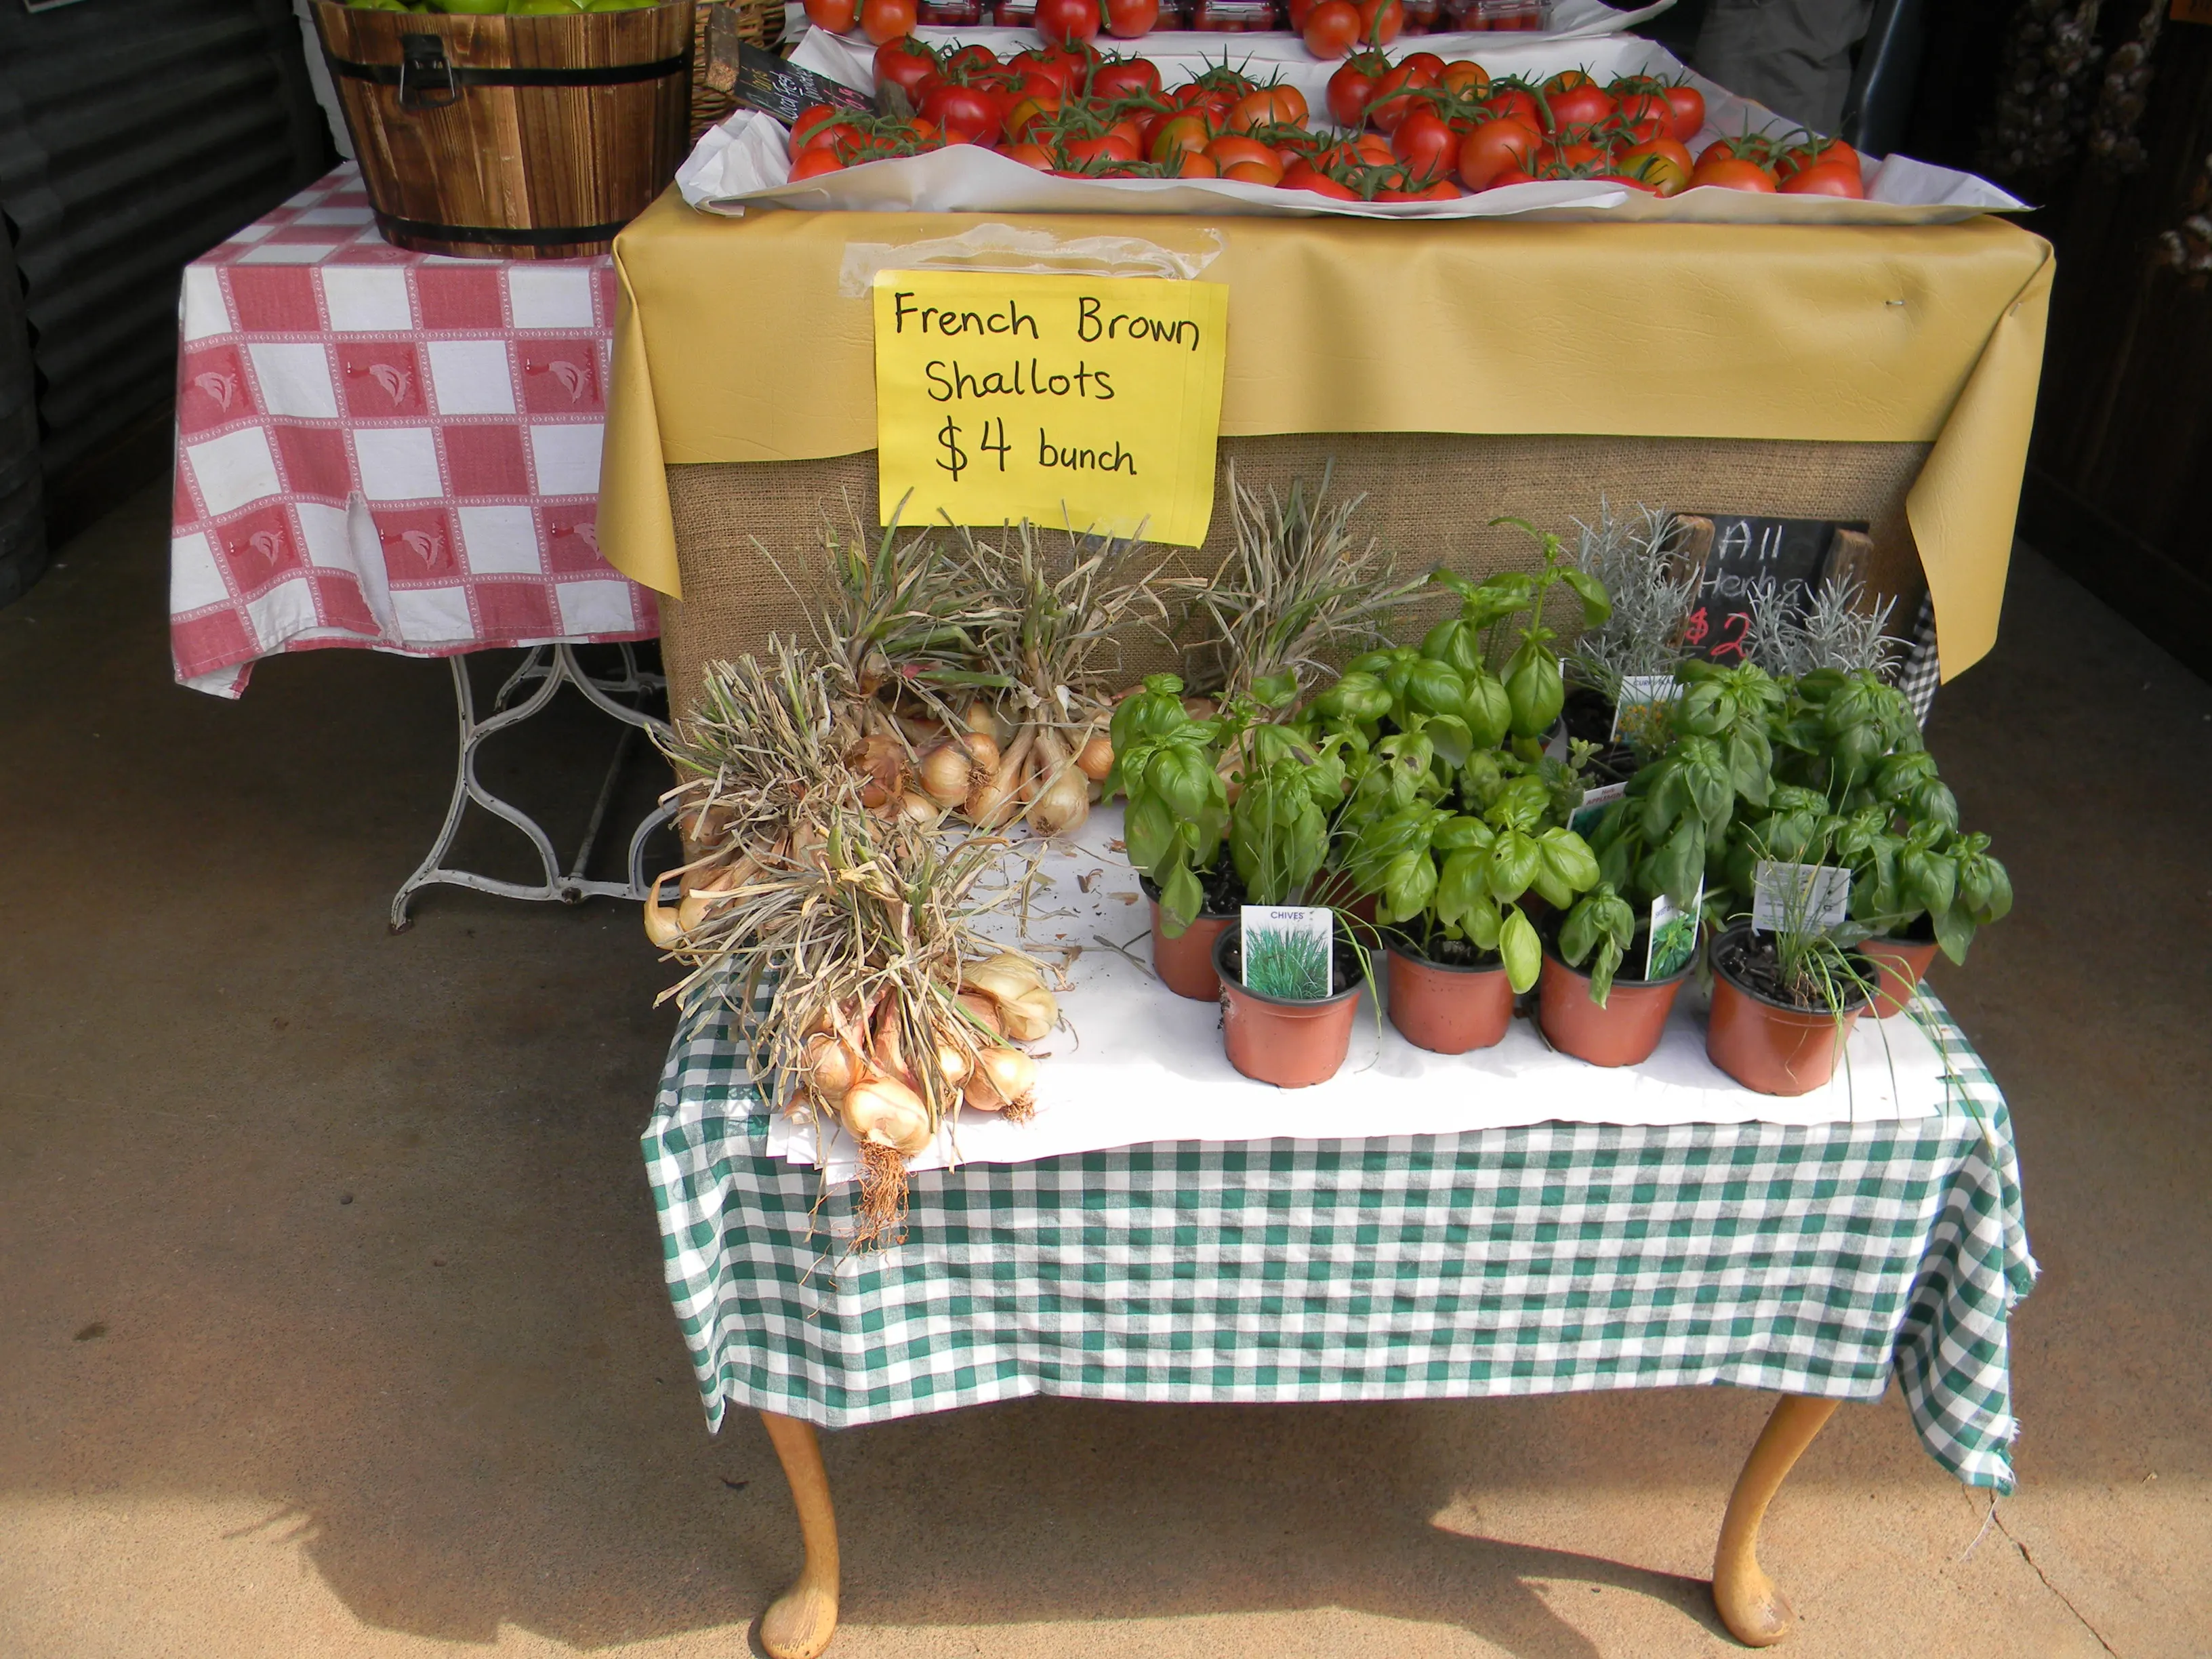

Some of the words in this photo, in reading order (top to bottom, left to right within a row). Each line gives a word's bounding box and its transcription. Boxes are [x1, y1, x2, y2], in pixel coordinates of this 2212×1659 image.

[895, 292, 1039, 339] French
[1078, 297, 1200, 351] Brown
[925, 357, 1115, 401] Shallots
[935, 415, 1012, 482] $4
[1038, 427, 1138, 475] bunch
[1718, 520, 1783, 560] All
[1685, 607, 1752, 657] $2
[1271, 911, 1305, 920] CHIVES
